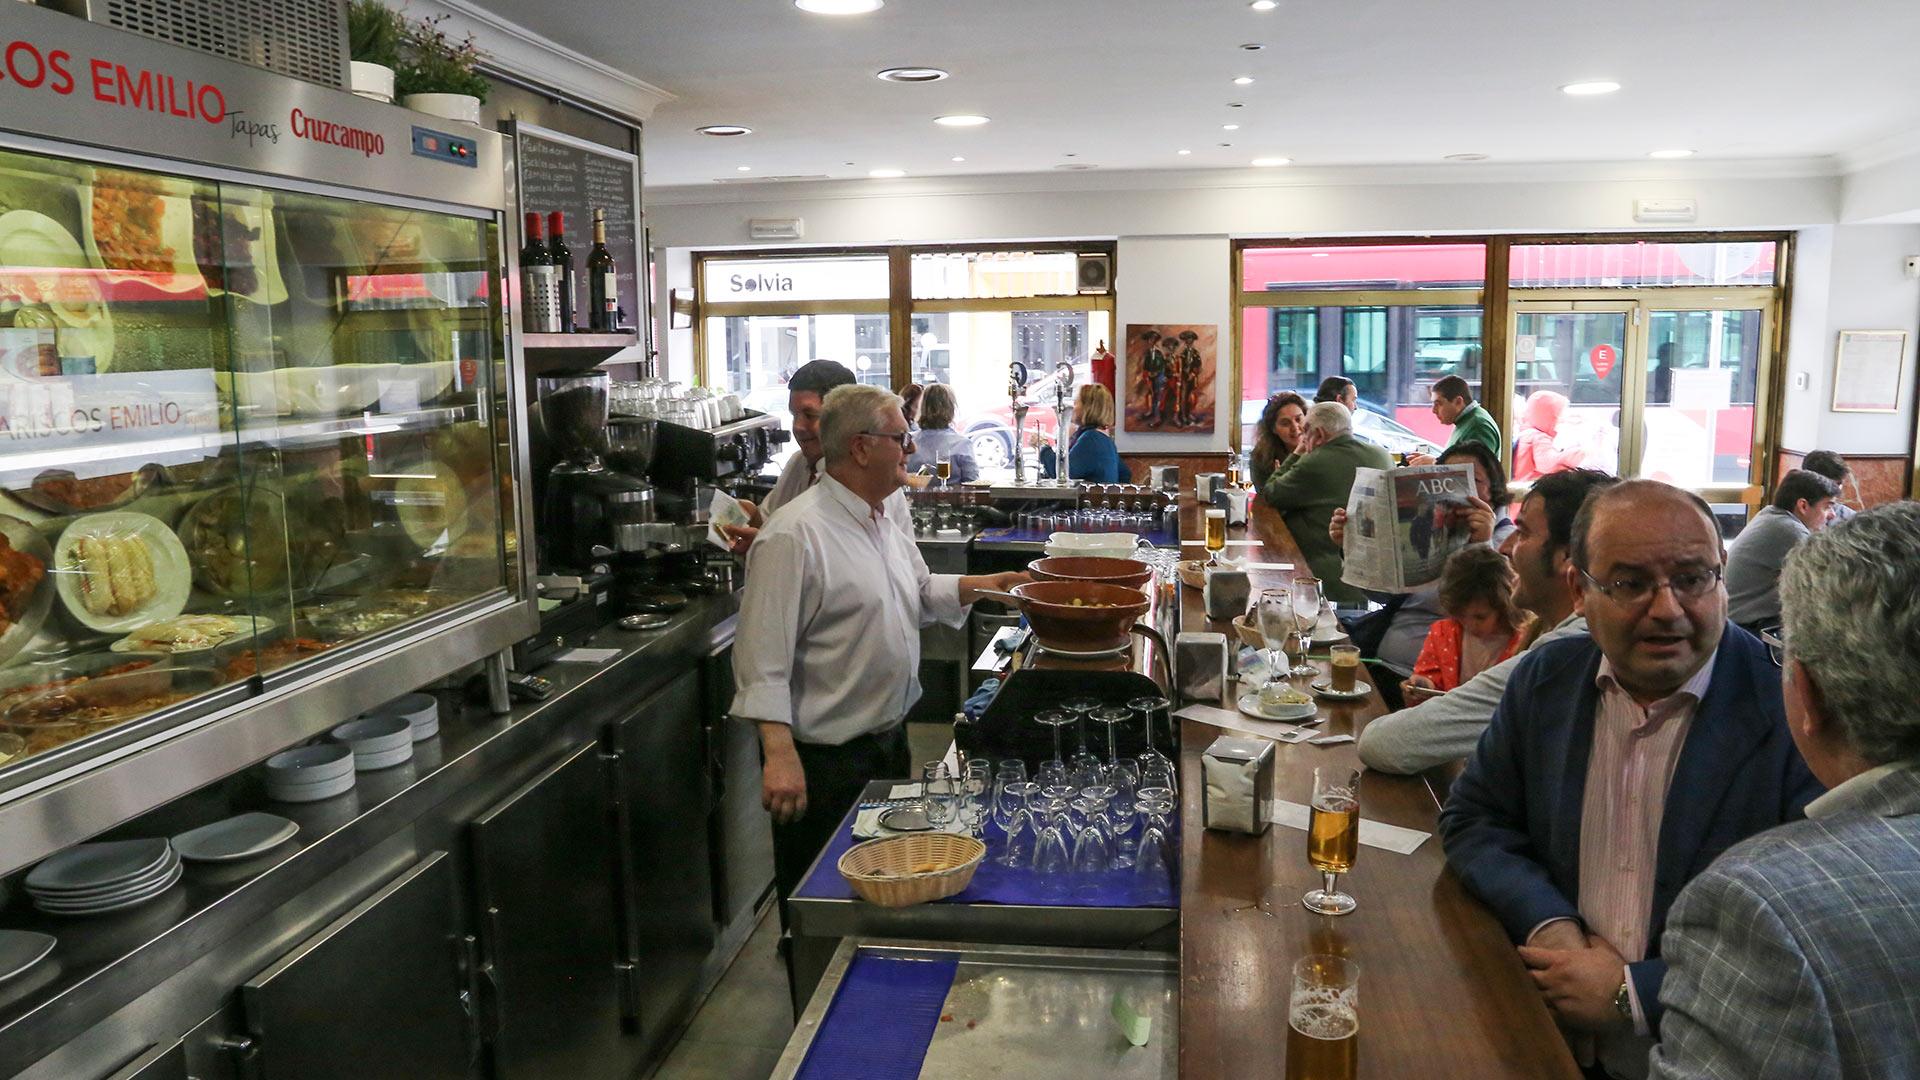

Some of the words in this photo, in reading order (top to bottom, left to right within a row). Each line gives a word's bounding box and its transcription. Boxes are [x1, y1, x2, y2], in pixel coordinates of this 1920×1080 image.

[0, 40, 75, 96] OS
[90, 57, 227, 125] EMILIO
[224, 108, 281, 148] Tapas
[289, 107, 385, 158] Cruzcampo
[730, 272, 794, 293] Solvia
[1599, 350, 1607, 360] E
[109, 401, 181, 431] EMILIO
[1415, 477, 1457, 497] ABC
